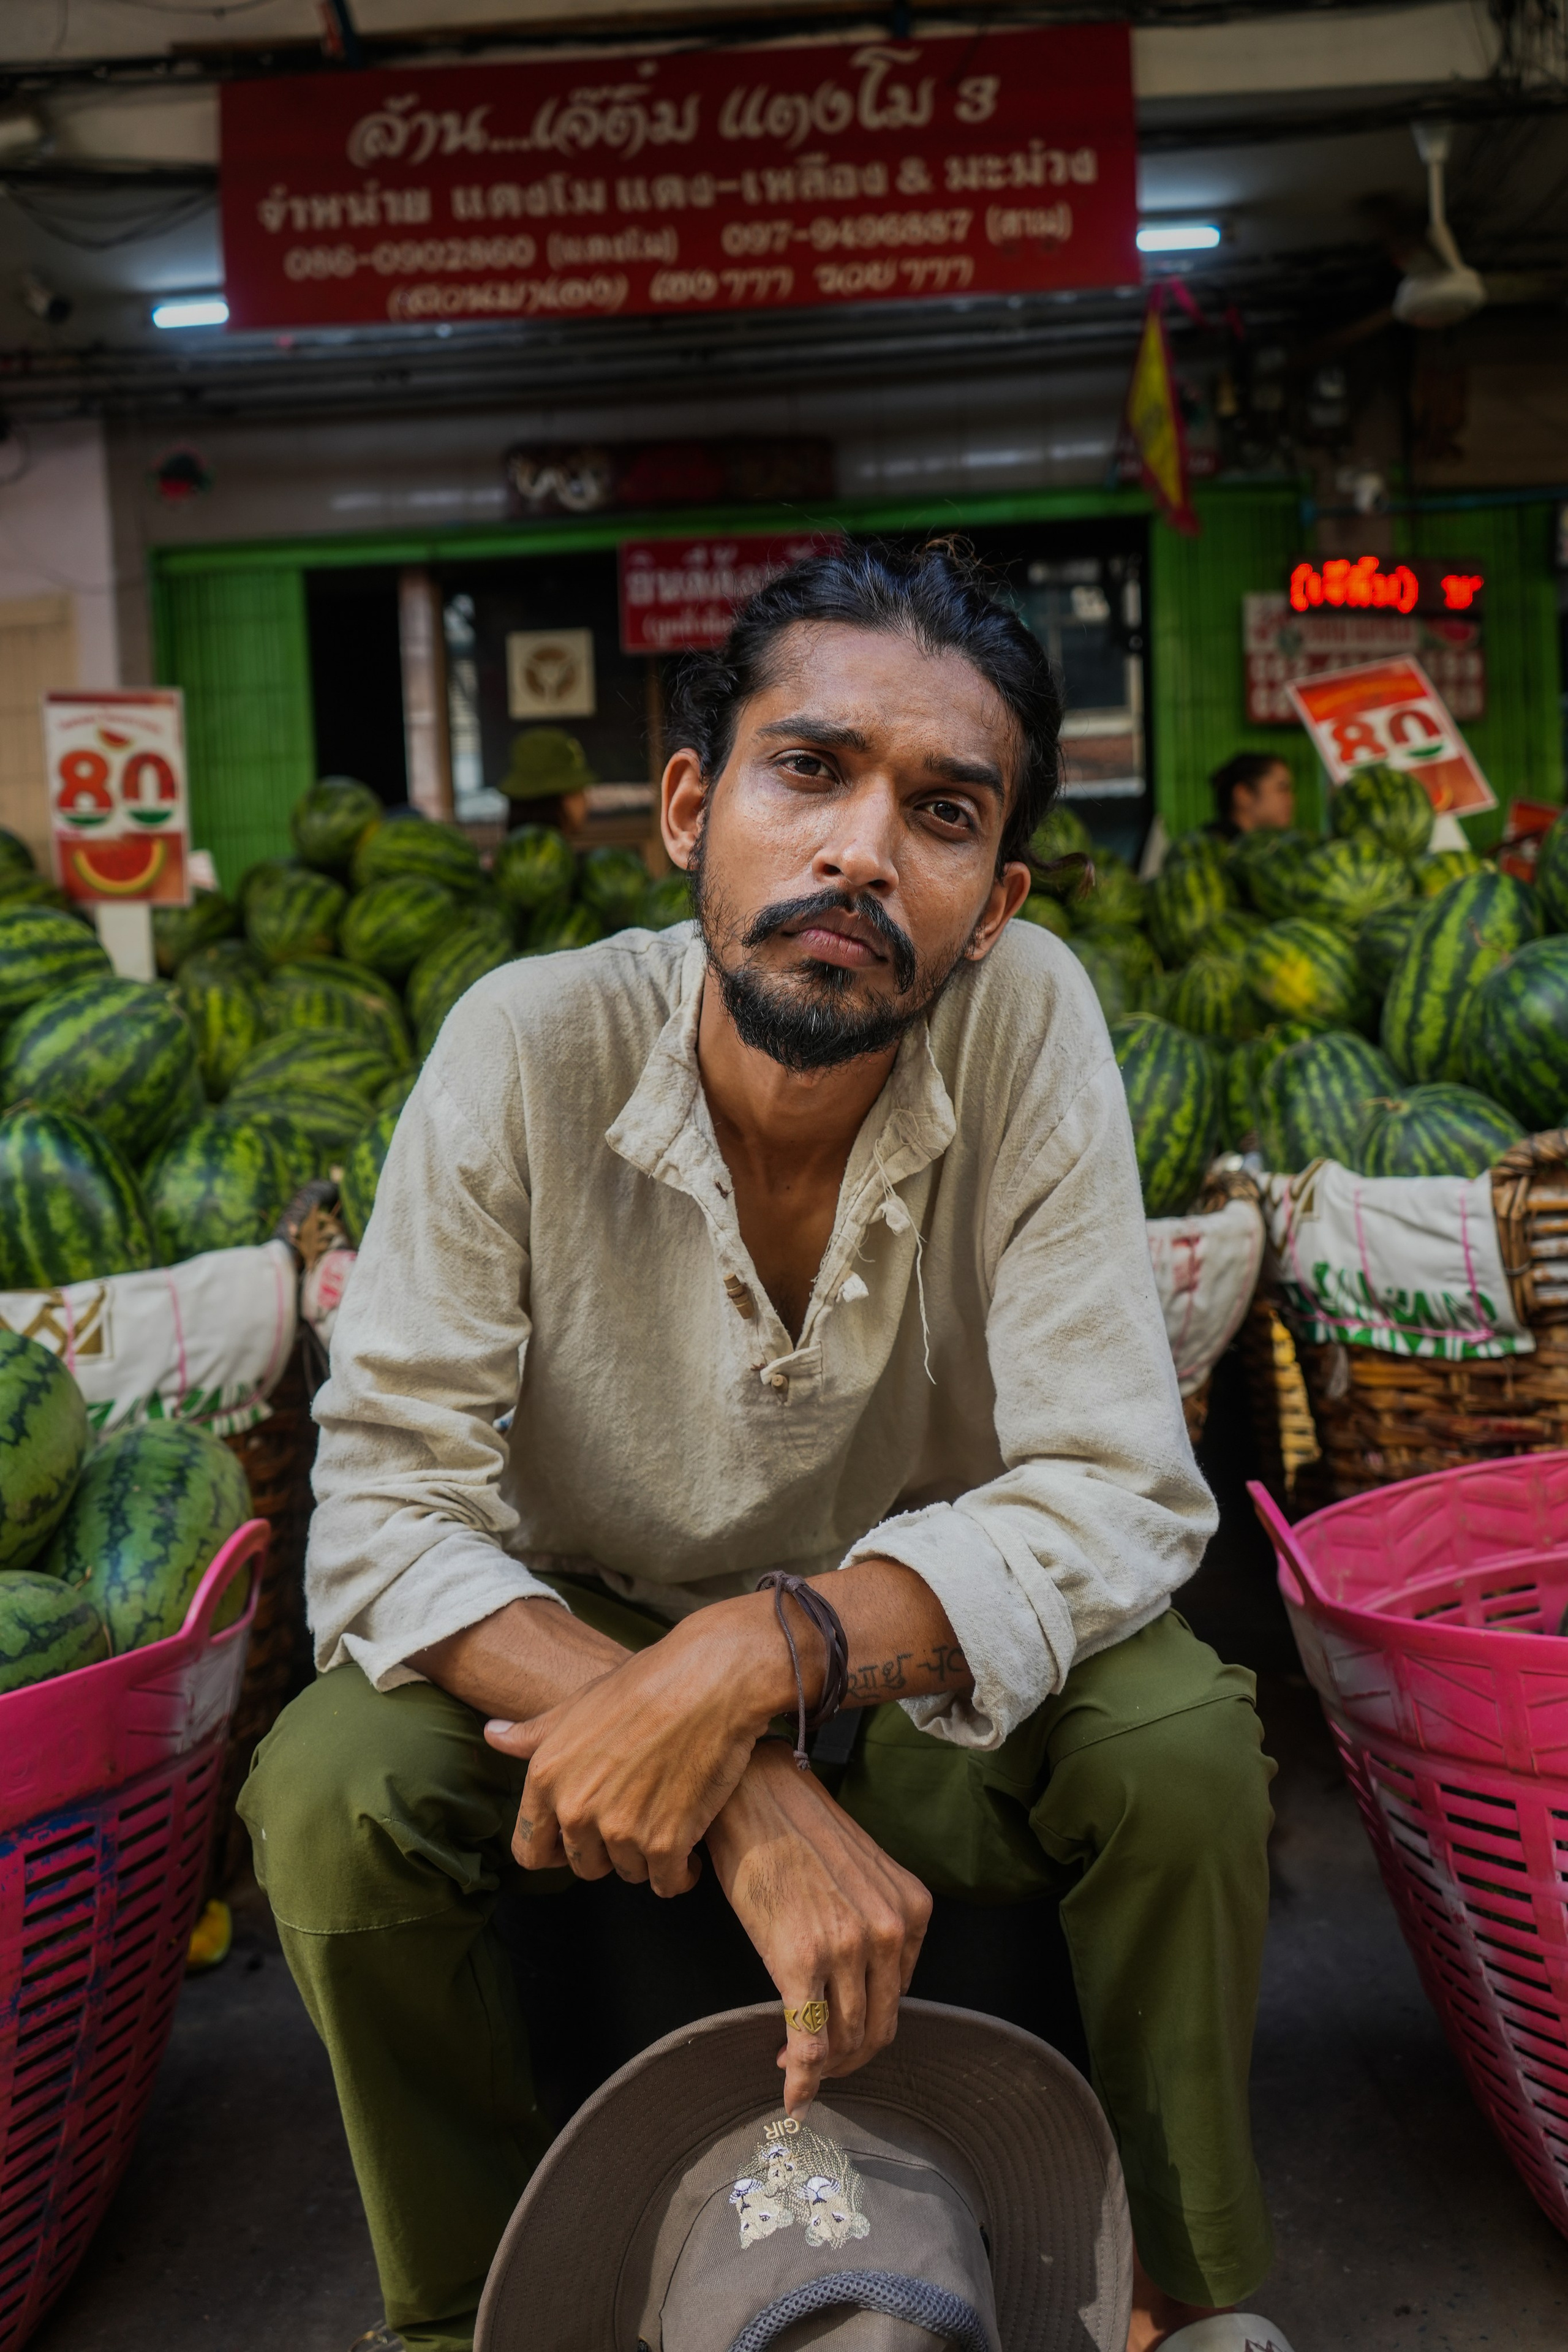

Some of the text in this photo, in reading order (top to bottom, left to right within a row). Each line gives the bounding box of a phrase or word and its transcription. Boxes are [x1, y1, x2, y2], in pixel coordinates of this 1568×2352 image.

[718, 47, 937, 150] แตงโม
[955, 75, 1000, 122] 3
[260, 184, 430, 232] จำหน่าย
[896, 155, 932, 195] &
[944, 139, 1098, 191] มะม่วง
[1329, 709, 1446, 766] 80
[58, 750, 176, 826] 80
